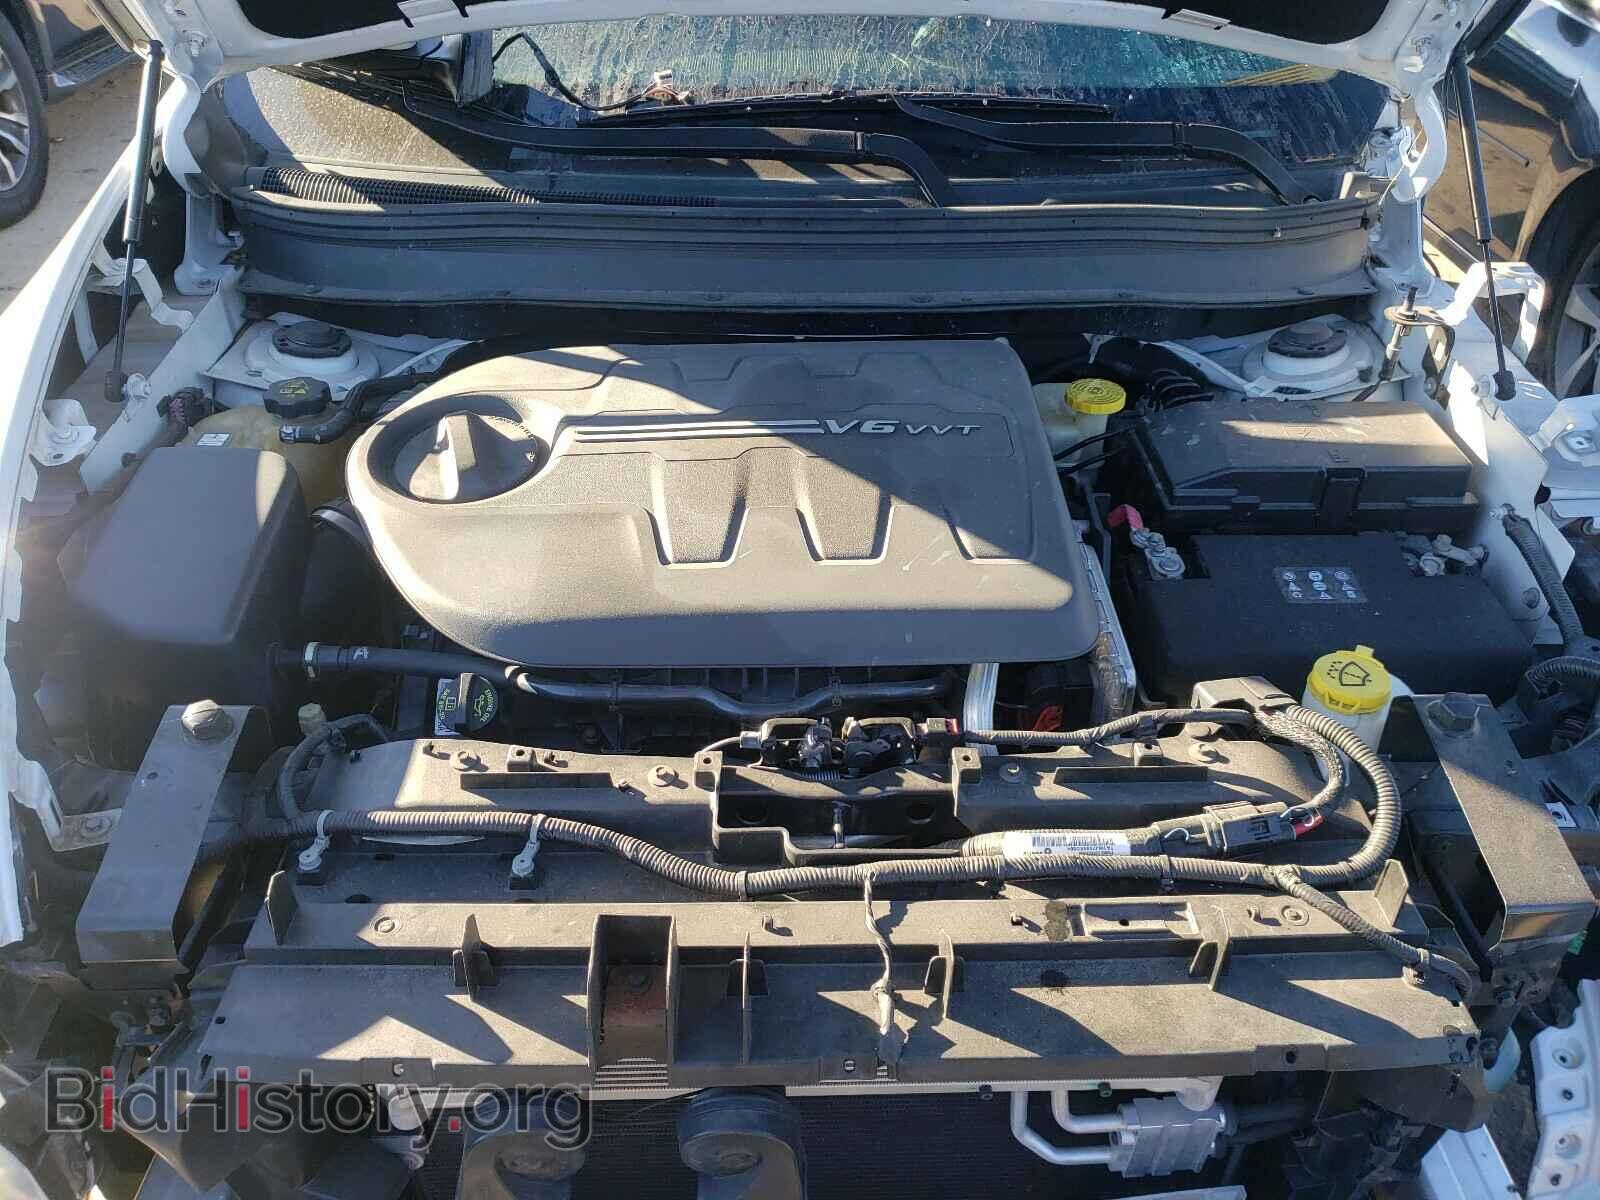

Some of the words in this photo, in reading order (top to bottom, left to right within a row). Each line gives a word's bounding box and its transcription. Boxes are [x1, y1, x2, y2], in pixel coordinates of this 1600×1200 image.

[825, 419, 900, 434] V6
[904, 424, 984, 435] VVT
[484, 689, 494, 712] ENGINE
[480, 712, 490, 722] OIL
